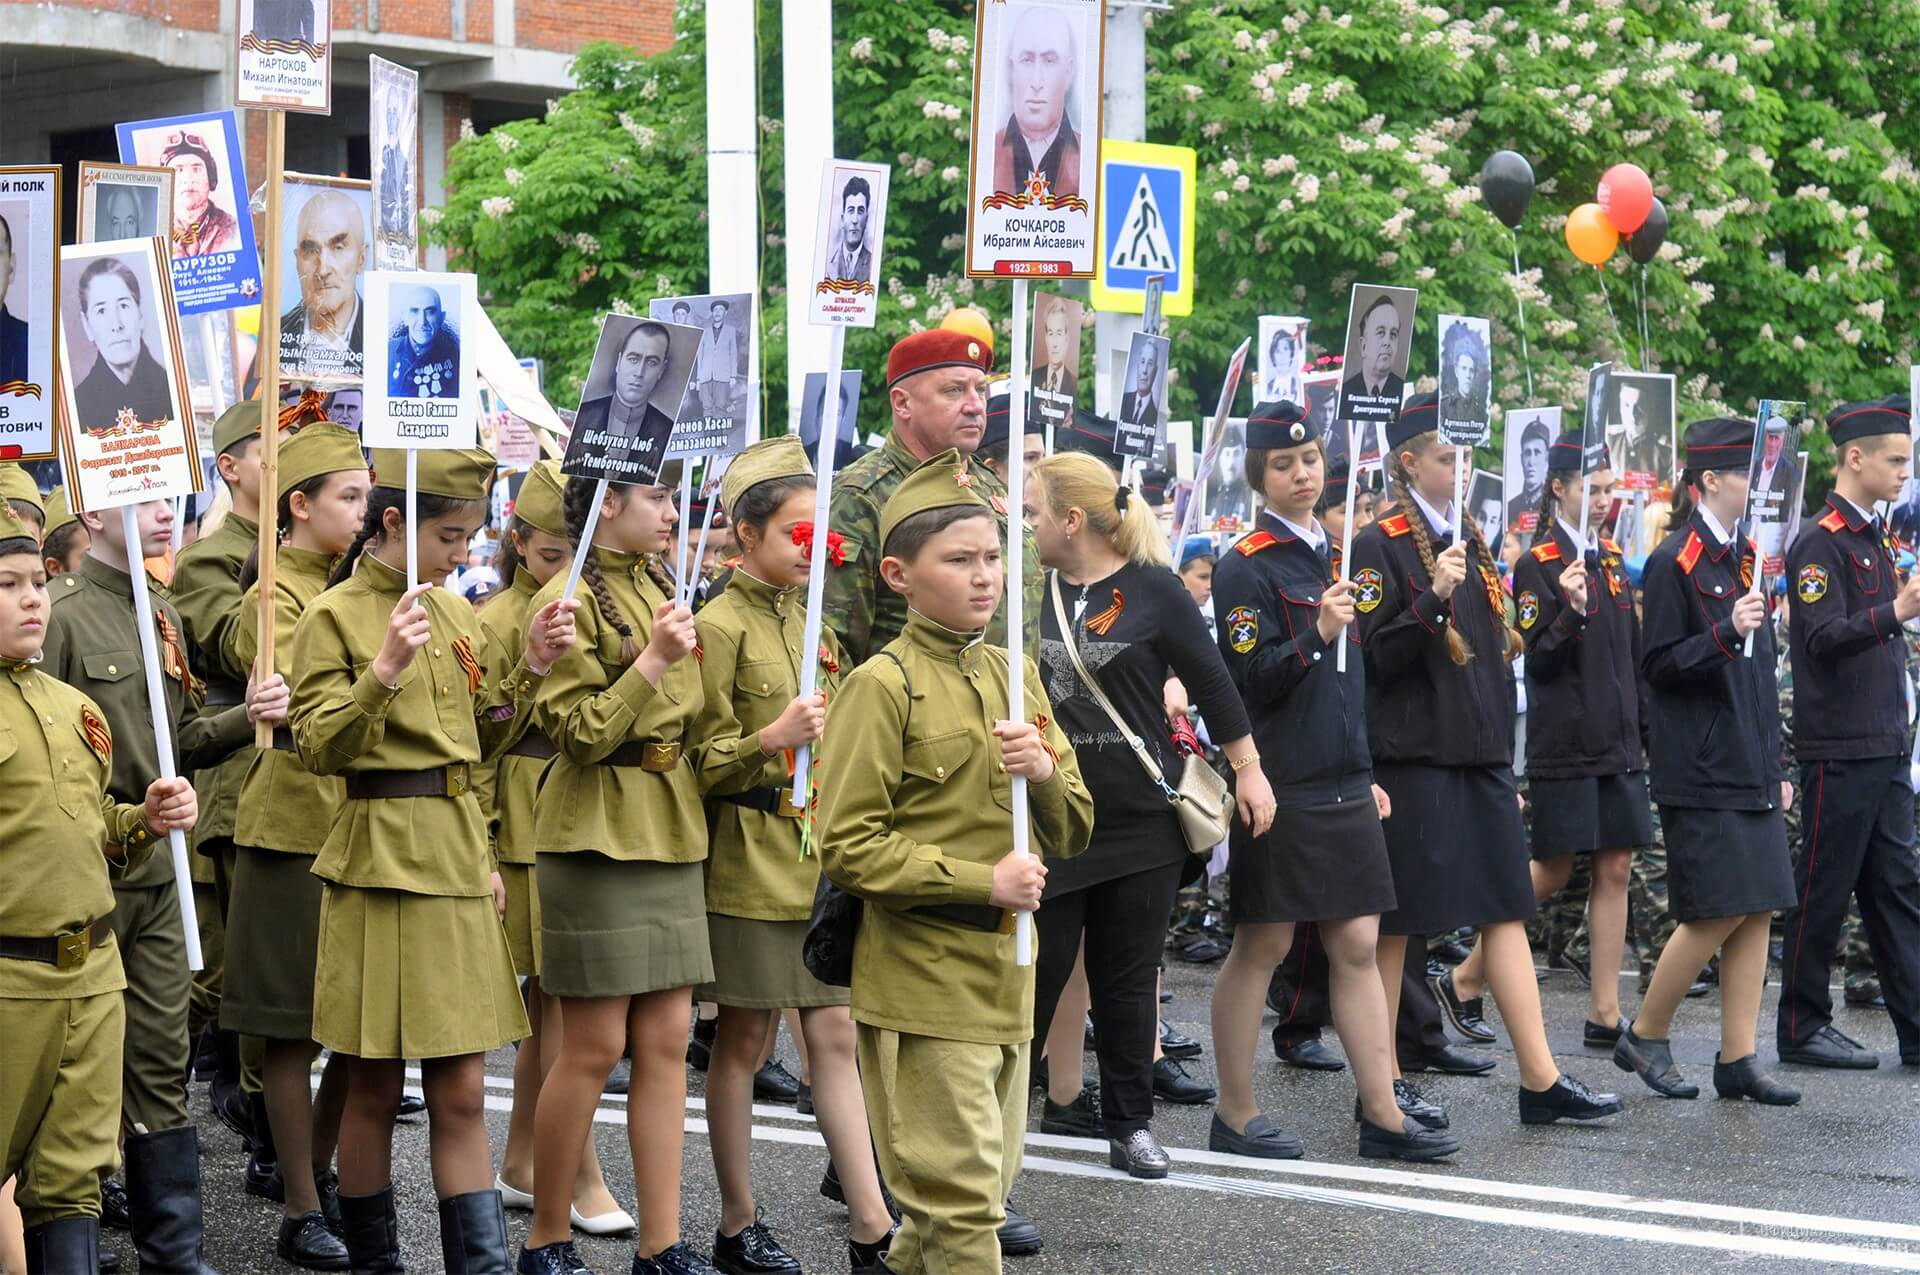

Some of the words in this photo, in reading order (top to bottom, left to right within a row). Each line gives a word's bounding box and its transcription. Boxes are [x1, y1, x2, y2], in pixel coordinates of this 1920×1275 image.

[259, 57, 307, 72] НАРТОКОВ
[243, 69, 276, 83] Михаил
[278, 73, 323, 88] Игнатович
[13, 181, 45, 192] ПОЛК
[1005, 218, 1066, 233] КОЧКАРОВ
[983, 234, 1030, 250] Ибрагим
[1033, 235, 1085, 249] Айсаевич
[1009, 263, 1030, 273] 1923
[1039, 263, 1059, 273] 1983
[1378, 395, 1399, 406] Сергей
[388, 400, 425, 417] Коблев
[425, 401, 458, 418] Галим
[397, 421, 449, 439] Асхадович
[704, 416, 733, 431] Хасан
[101, 434, 161, 453] БАЛКАРОВА
[582, 429, 630, 452] Шебзухов
[630, 436, 655, 453] Аюб
[582, 452, 640, 474] Темботович
